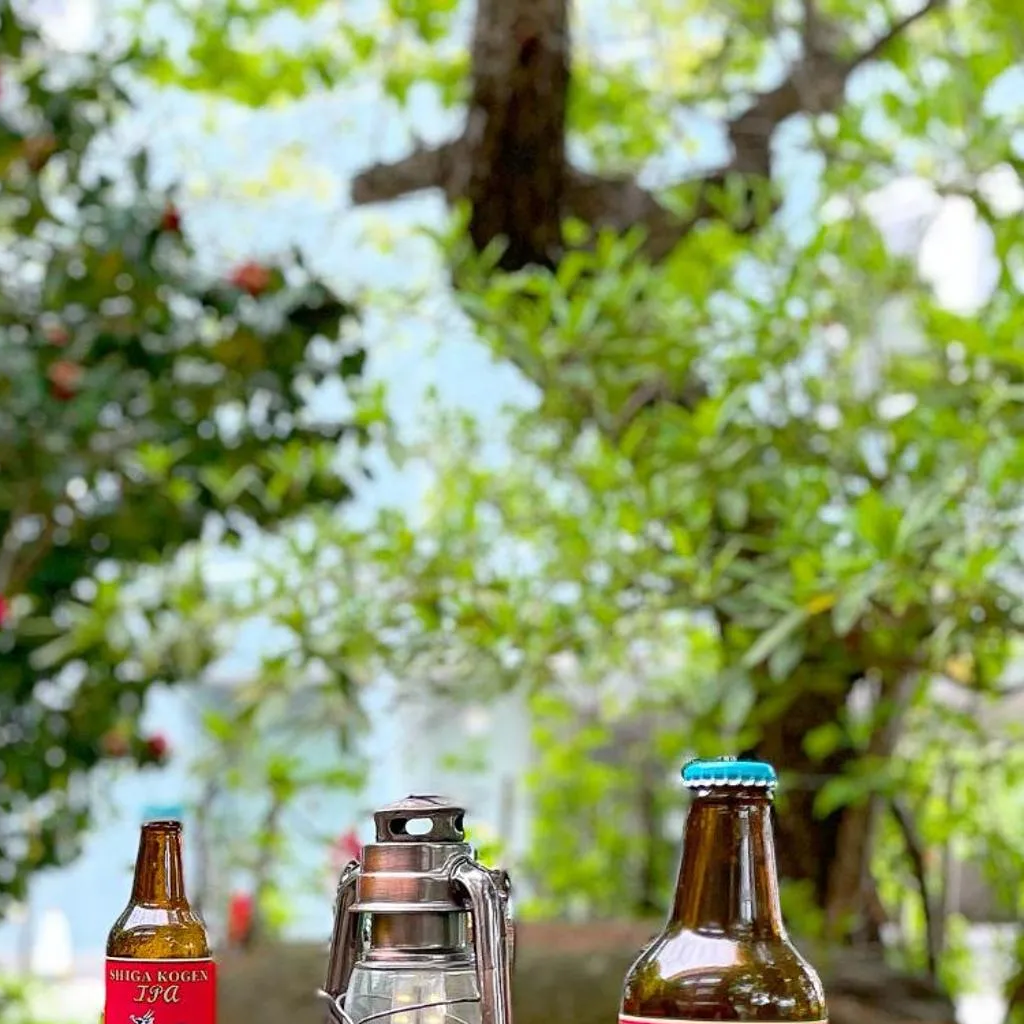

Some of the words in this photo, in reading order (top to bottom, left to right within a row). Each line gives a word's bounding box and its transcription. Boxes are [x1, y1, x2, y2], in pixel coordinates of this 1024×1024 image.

[109, 968, 152, 982] SHIGA
[157, 969, 209, 983] KOGEN
[133, 985, 181, 1003] IPA
